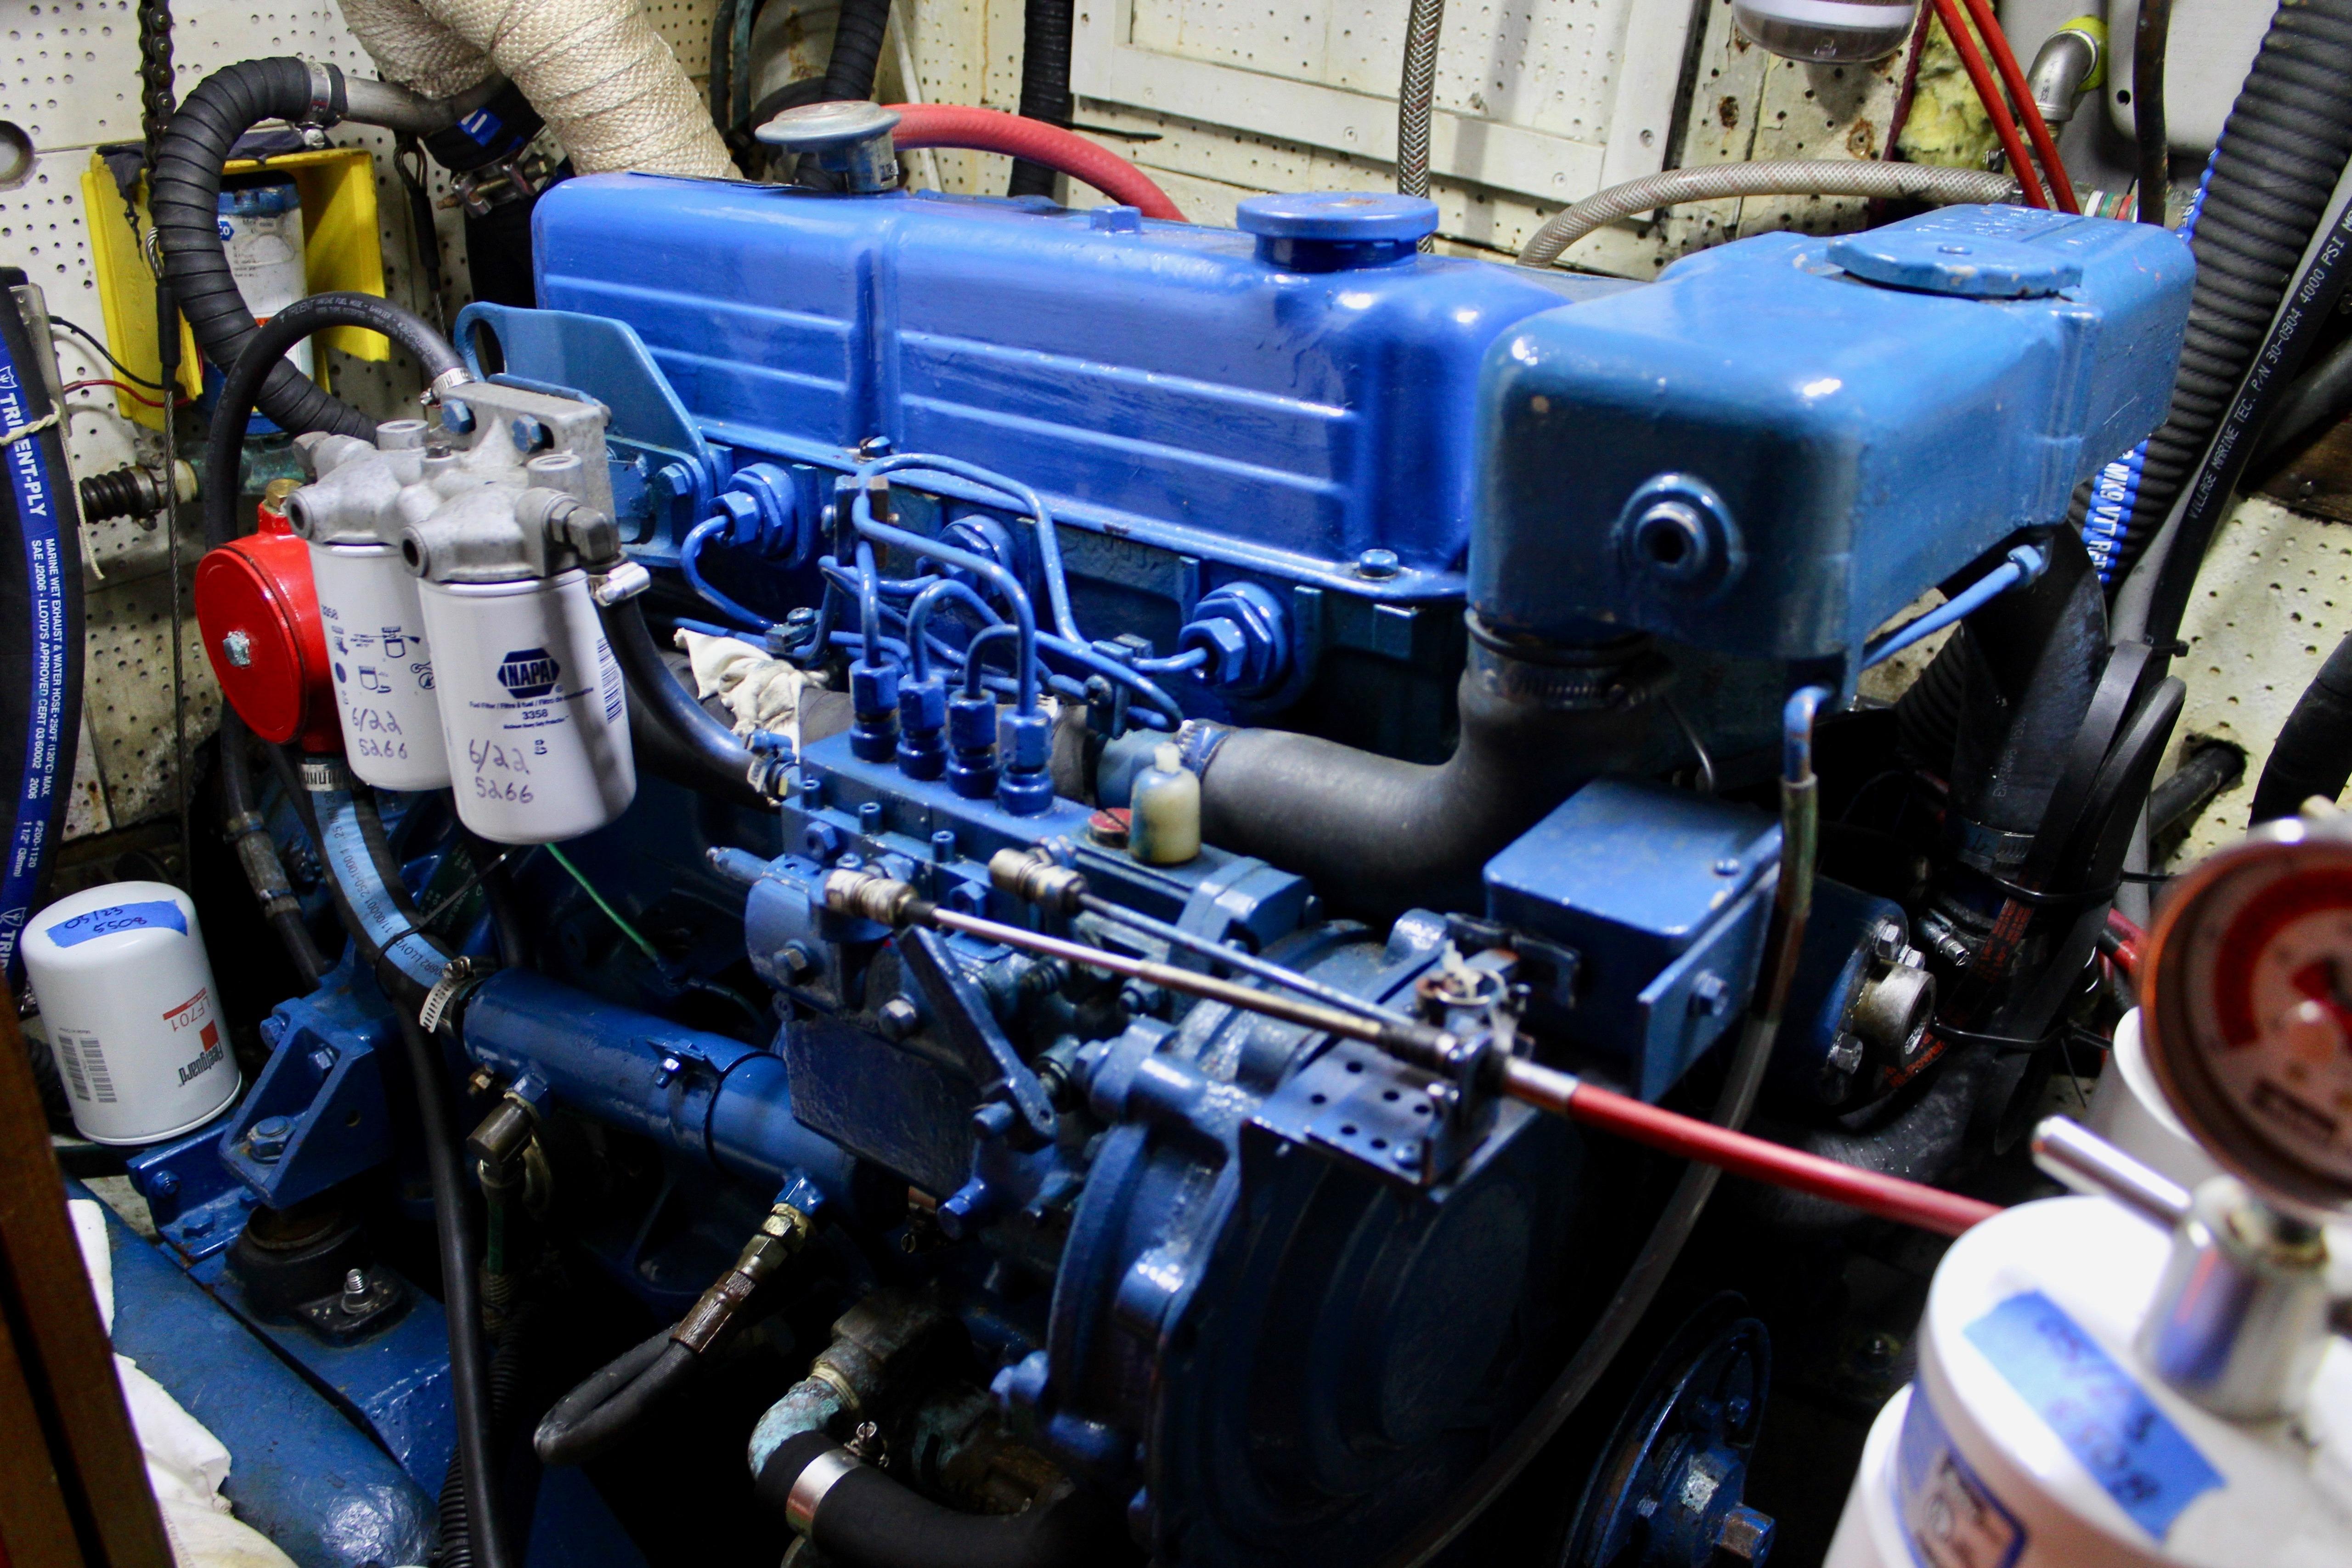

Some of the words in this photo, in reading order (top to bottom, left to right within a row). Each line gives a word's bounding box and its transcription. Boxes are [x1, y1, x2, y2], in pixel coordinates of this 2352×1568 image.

[2188, 470, 2217, 519] VILLAGE
[2214, 425, 2240, 470] MARINE
[2250, 364, 2271, 392] P/N
[2266, 307, 2303, 365] 30-0904
[2300, 268, 2325, 304] 4000
[2321, 235, 2345, 267] PSI
[0, 390, 47, 517] TRIENT-PLY
[2099, 462, 2130, 502] MK9
[31, 540, 43, 560] SAE
[45, 538, 58, 575] MARINE
[34, 563, 46, 591] J2006
[50, 576, 61, 598] WET
[38, 599, 50, 639] LLOYD'S
[51, 599, 62, 643] EXHAUST
[39, 641, 50, 697] APPROVED
[53, 653, 62, 686] WATER
[507, 659, 551, 688] NAPA
[36, 699, 48, 726] CERT
[352, 708, 402, 735] 6/22
[522, 709, 548, 720] 3358
[359, 738, 408, 760] 5266
[469, 739, 530, 775] 6/22
[28, 777, 39, 800] 2006
[41, 775, 52, 798] MAX.
[474, 776, 535, 804] 5266
[28, 820, 45, 868] #200-1120
[13, 847, 27, 878] (38mm)
[343, 855, 367, 897] 250-1000
[169, 996, 211, 1032] LF701
[178, 1042, 224, 1087] Fleetguard
